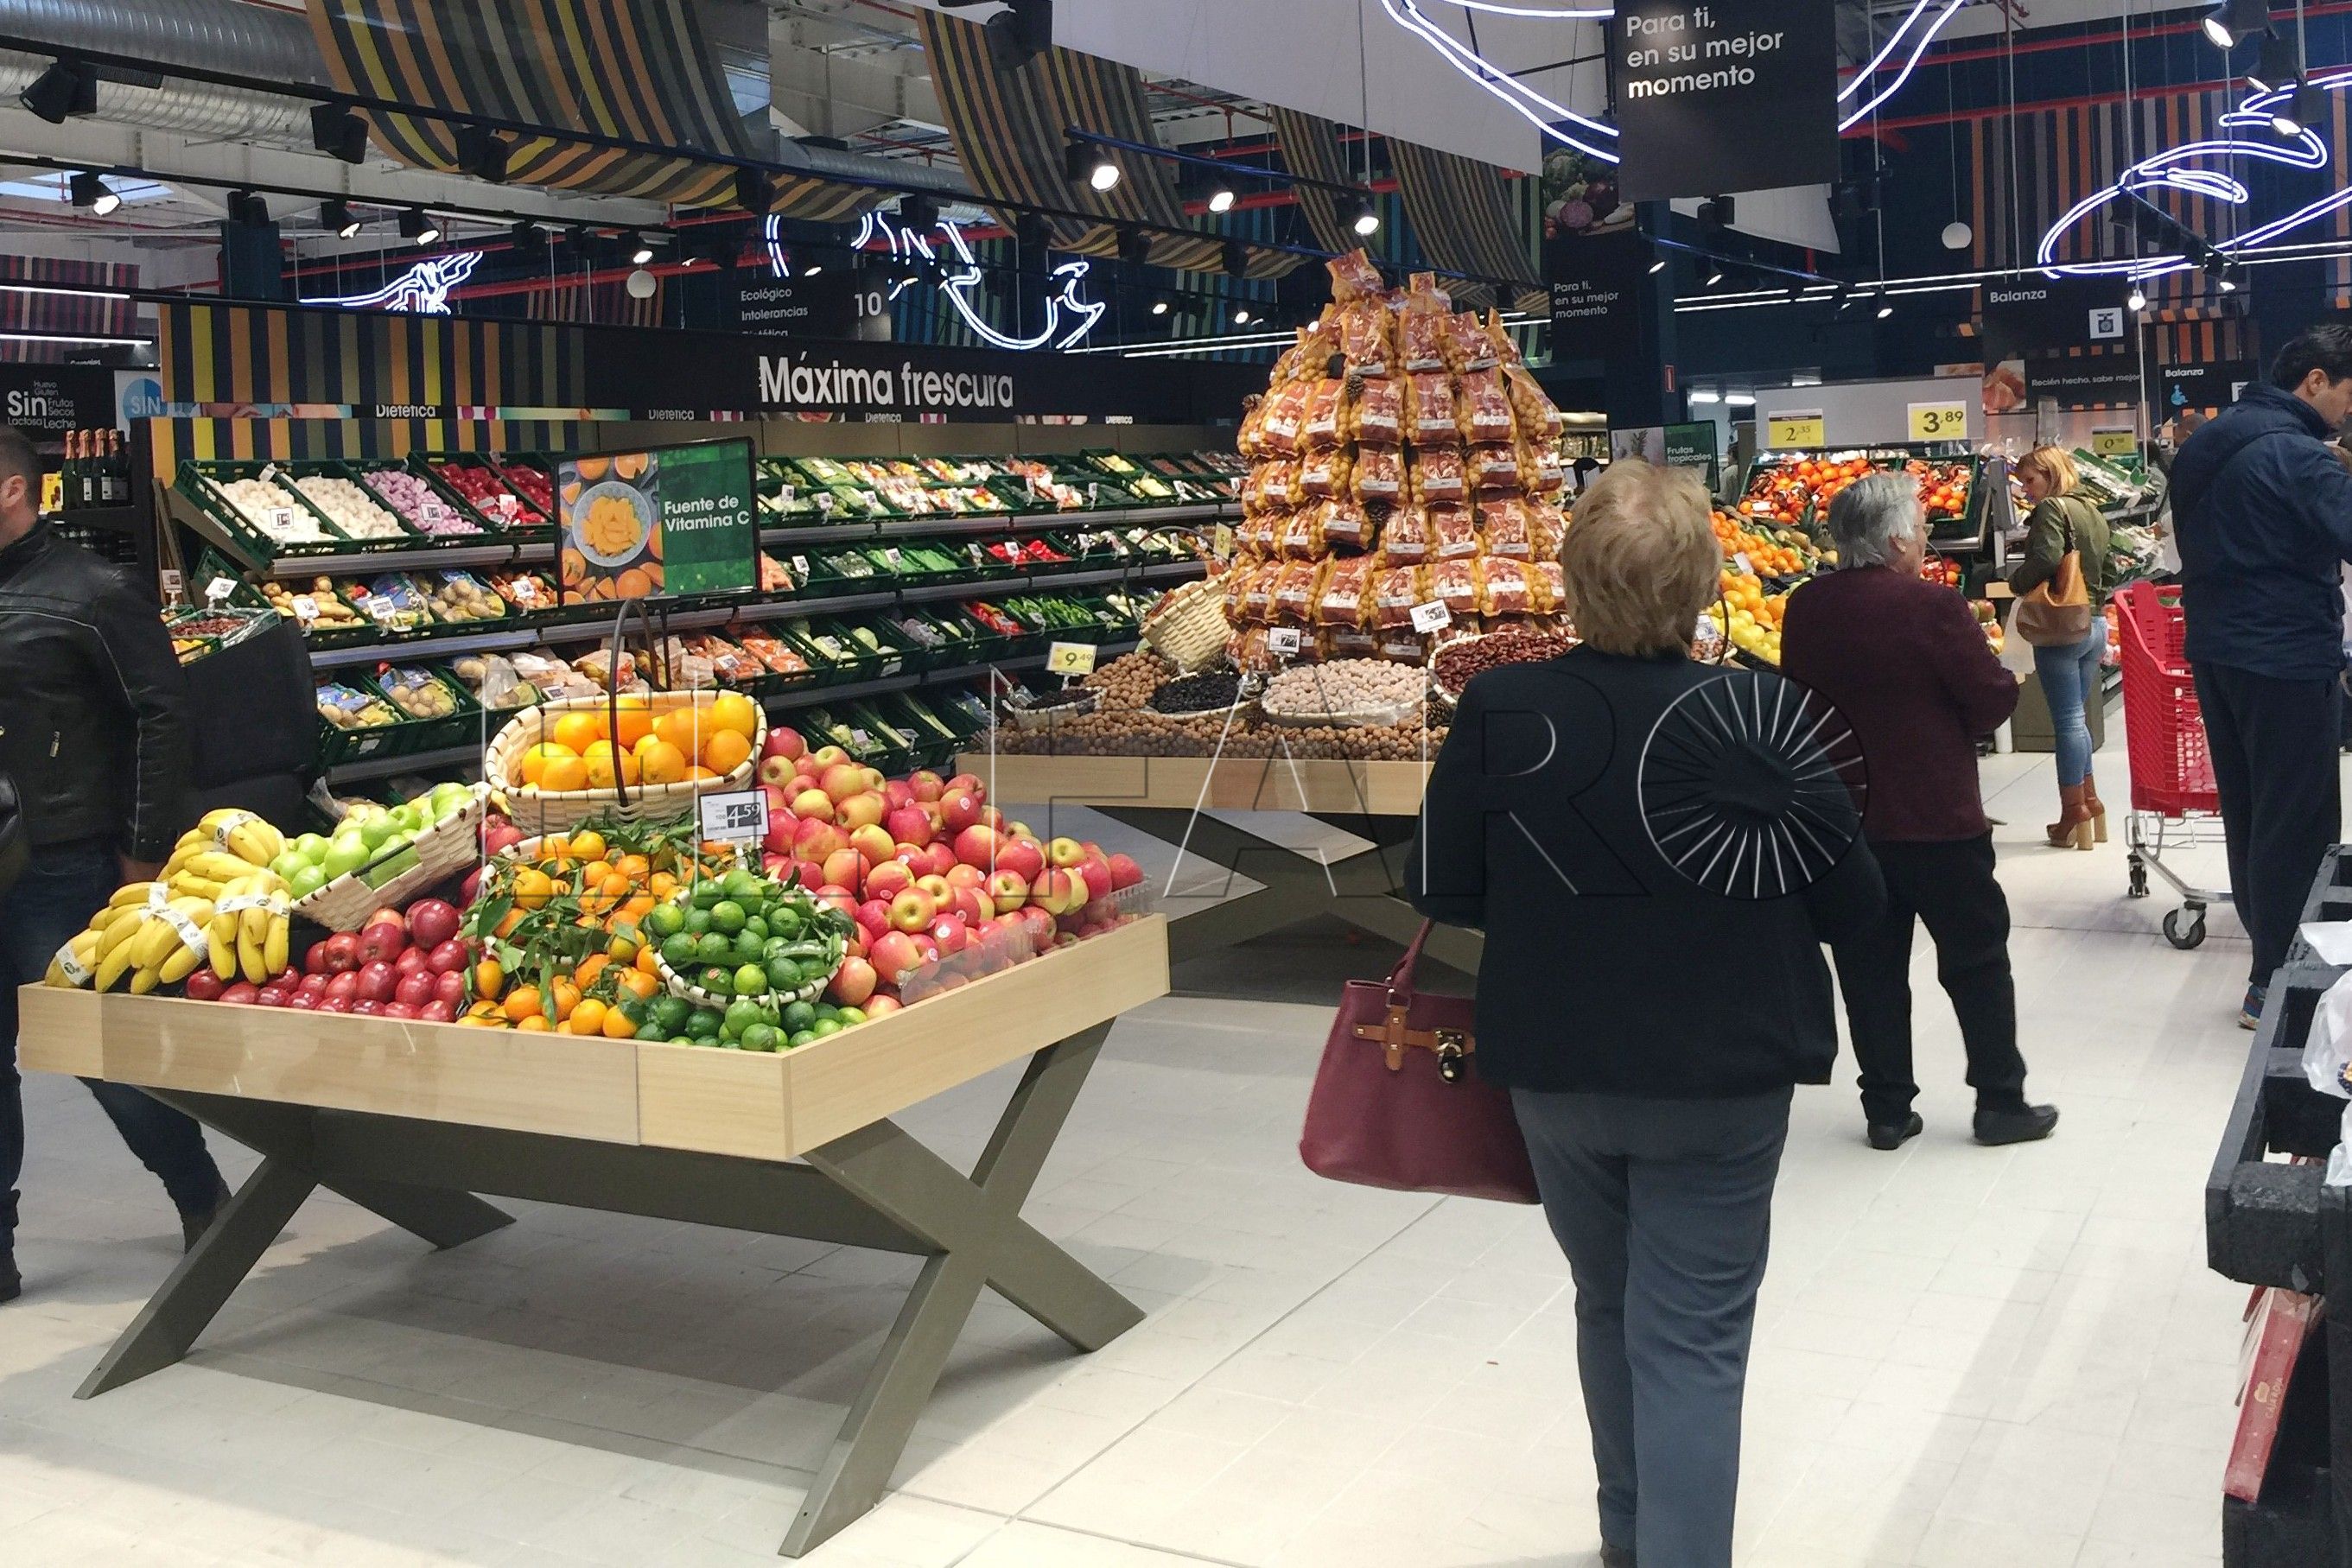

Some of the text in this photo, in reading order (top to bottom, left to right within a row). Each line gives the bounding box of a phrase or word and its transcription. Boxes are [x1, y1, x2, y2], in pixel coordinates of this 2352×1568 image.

[1626, 6, 1716, 37] Para ti,
[1626, 31, 1784, 67] en su mejor
[1628, 65, 1756, 98] momento
[741, 288, 792, 302] Ecológico
[1554, 282, 1580, 293] Para
[1990, 290, 2047, 303] Balanza
[854, 291, 882, 317] 10
[1554, 291, 1619, 306] en su mejor
[741, 306, 808, 321] Intolerancias
[1555, 305, 1608, 319] momento
[759, 351, 1014, 408] Máxima frescura
[2164, 368, 2204, 378] Balanza
[7, 390, 47, 416] Sin
[131, 394, 161, 415] SIN
[43, 418, 77, 429] Leche
[1923, 410, 1964, 433] 3,89
[1667, 453, 1713, 464] tropicales
[664, 495, 739, 515] Fuente de
[664, 511, 750, 532] Vitamina C
